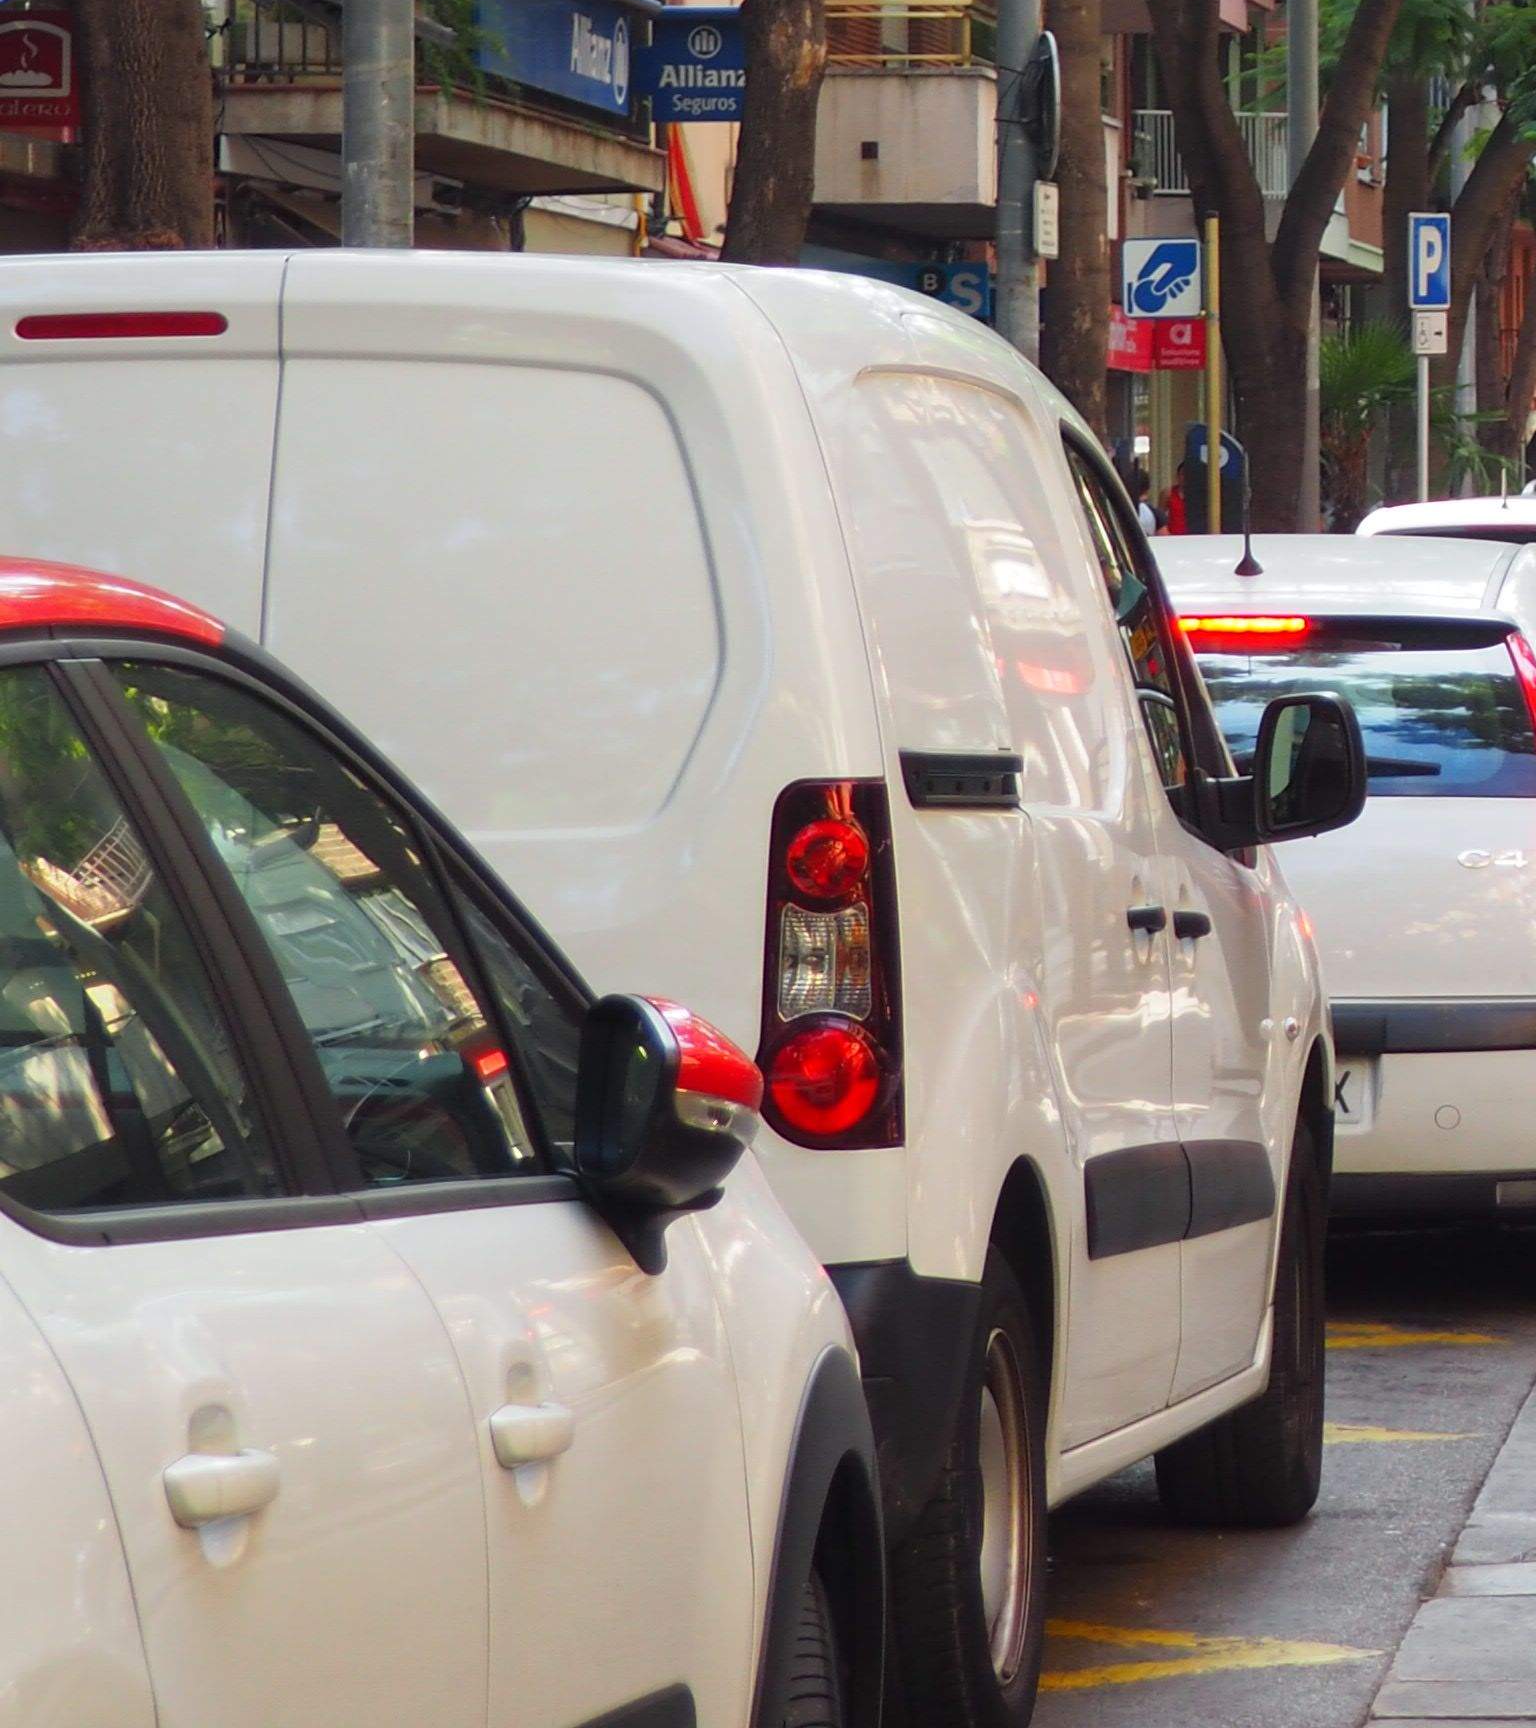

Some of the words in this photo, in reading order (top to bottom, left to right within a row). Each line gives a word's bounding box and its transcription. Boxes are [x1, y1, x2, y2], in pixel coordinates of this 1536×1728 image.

[570, 12, 612, 85] Allianz
[672, 94, 737, 115] Seguros
[1418, 225, 1442, 297] P
